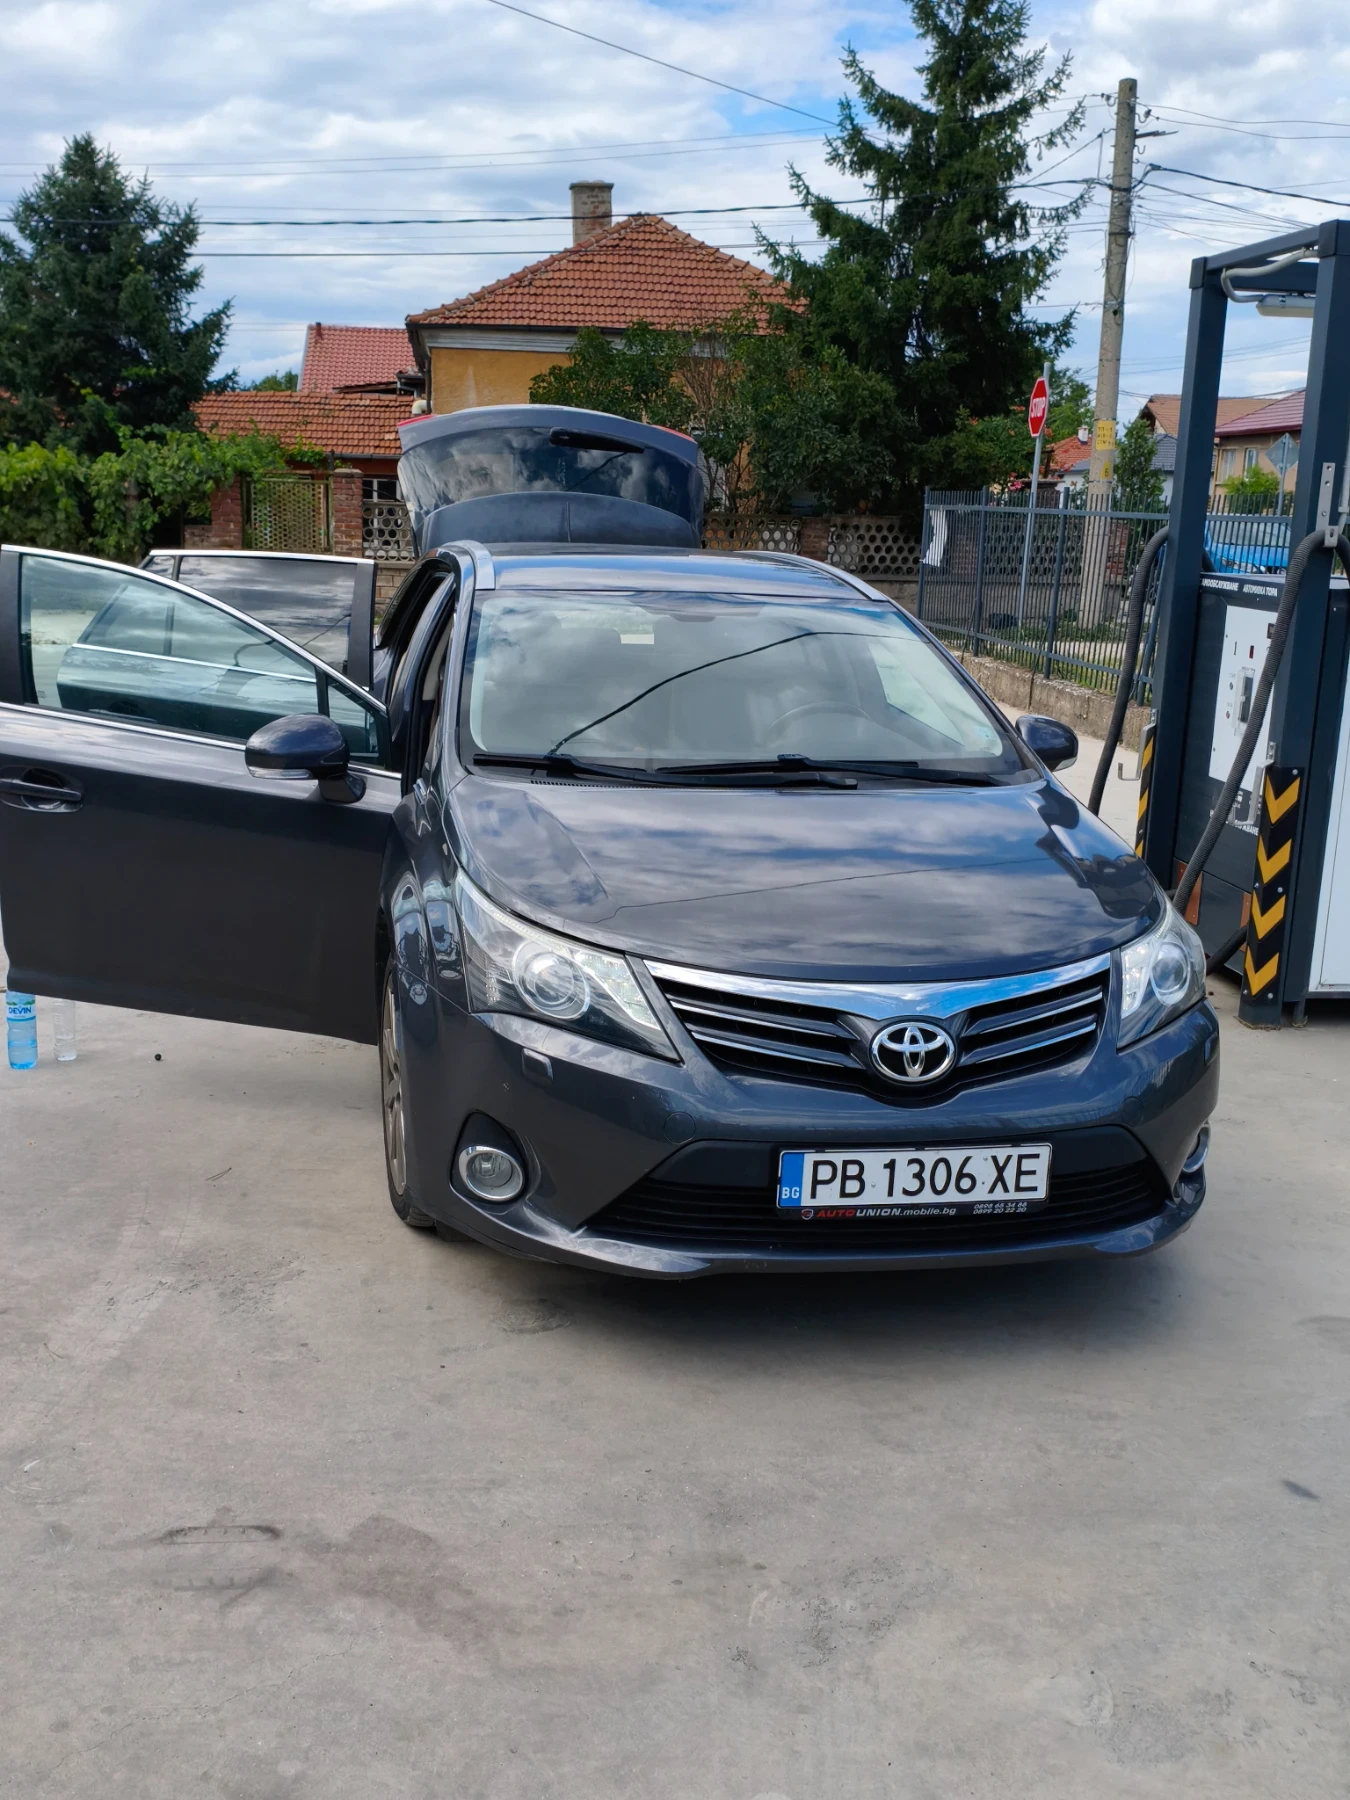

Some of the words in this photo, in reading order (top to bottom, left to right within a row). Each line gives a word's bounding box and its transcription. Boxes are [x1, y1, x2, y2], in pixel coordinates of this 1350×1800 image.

[1031, 397, 1046, 418] STOP
[1201, 578, 1239, 591] АМООБСЛУЖВАНЕ
[9, 1006, 32, 1015] DEVIN
[810, 1159, 866, 1199] PB
[883, 1155, 977, 1197] 1306
[987, 1153, 1041, 1195] XE
[782, 1187, 800, 1198] BG
